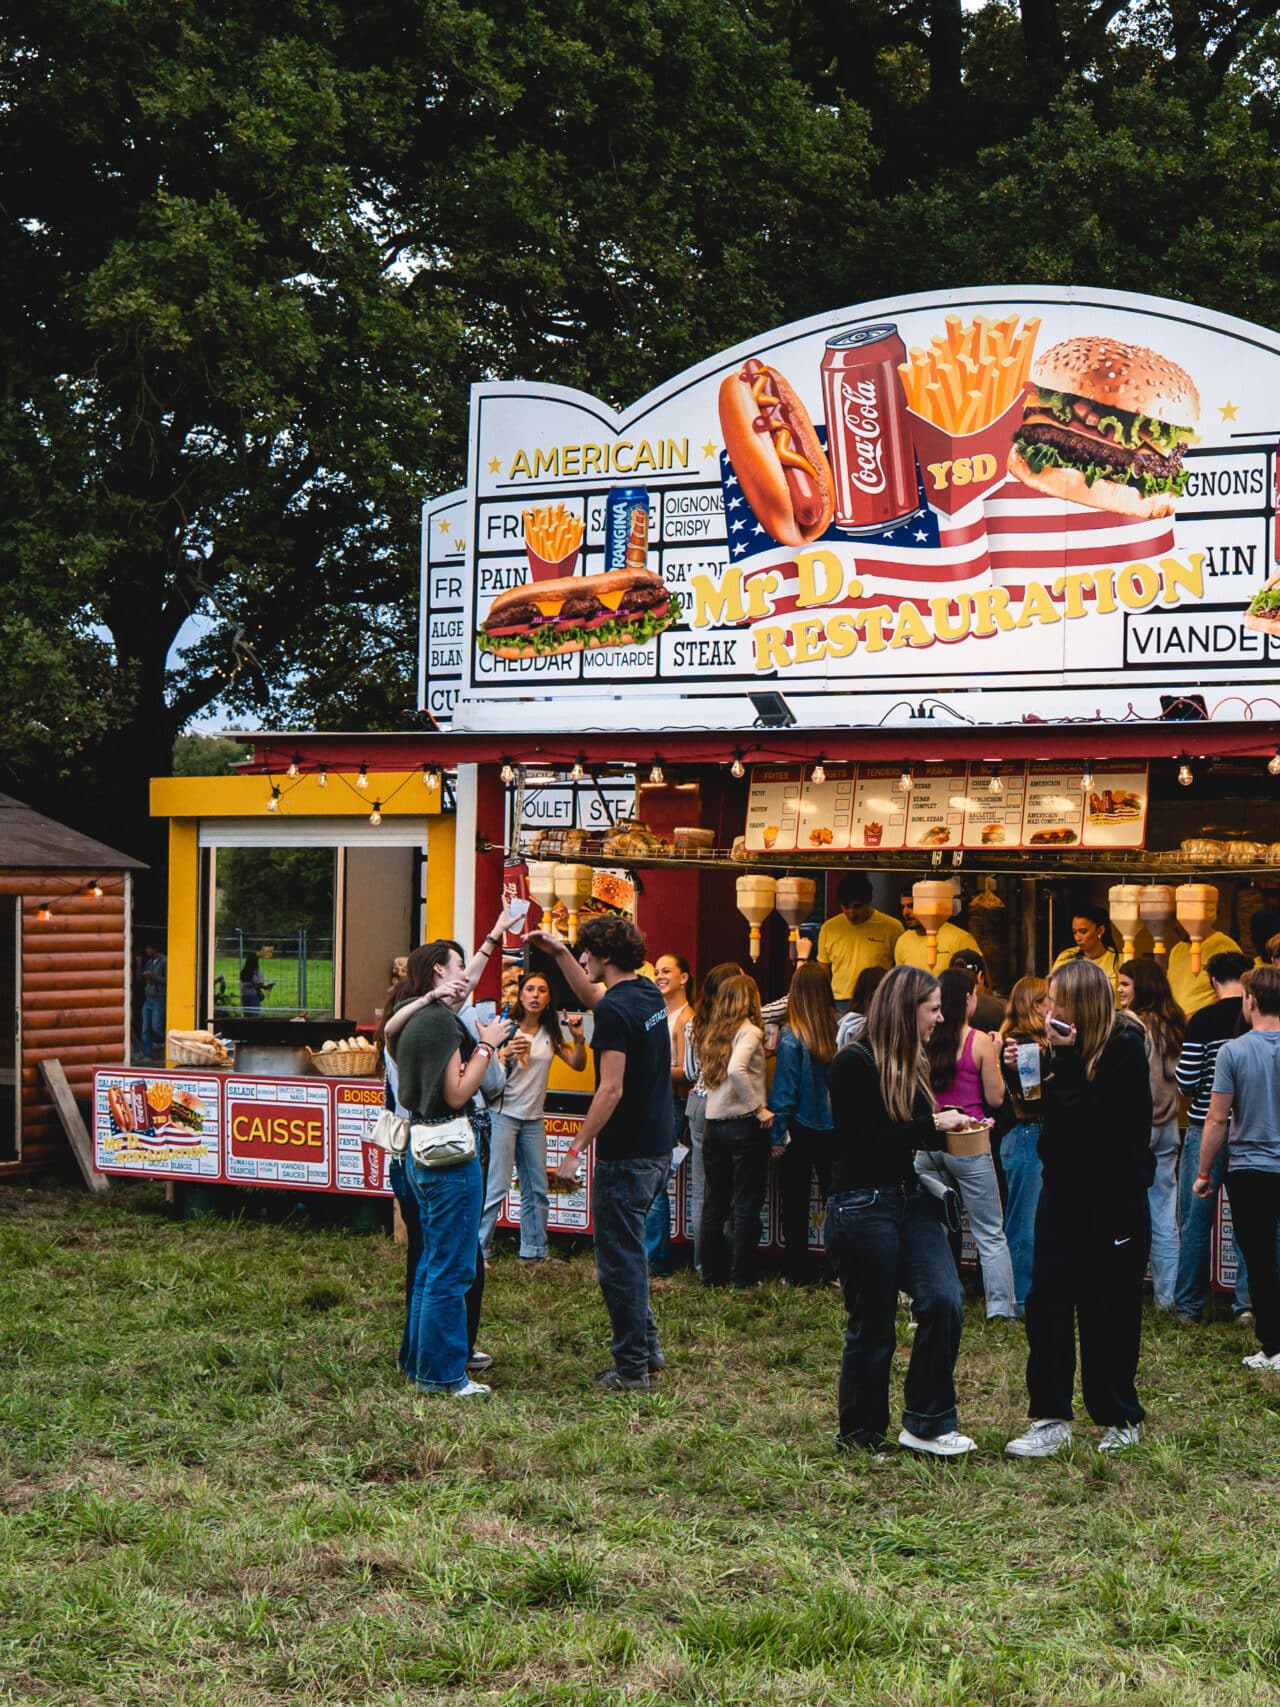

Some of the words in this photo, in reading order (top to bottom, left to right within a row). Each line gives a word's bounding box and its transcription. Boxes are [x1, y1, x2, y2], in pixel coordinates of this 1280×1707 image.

[841, 379, 886, 495] Coca-Cola
[508, 437, 689, 480] AMERICAIN
[927, 454, 997, 490] YSD
[1181, 469, 1264, 497] GNONS
[665, 495, 725, 514] OIGNONS
[487, 514, 528, 539] FRI
[612, 502, 628, 570] RANGINA
[665, 519, 711, 537] CRISPY
[1206, 546, 1256, 577] AIN
[480, 567, 528, 590] PAIN
[690, 567, 778, 628] Mr
[793, 549, 864, 608] D.
[752, 551, 1206, 671] RESTAURATION
[431, 621, 463, 638] ALGE
[1133, 625, 1258, 654] VIANDE
[431, 649, 463, 667] BLAN
[584, 652, 655, 667] MOUTARDE
[673, 640, 737, 667] STEAK
[522, 801, 571, 818] OULET
[229, 1087, 254, 1096] SALADE
[344, 1090, 386, 1103] BOISSO
[233, 1116, 322, 1147] CAISSE
[544, 1120, 581, 1134] RICAIN
